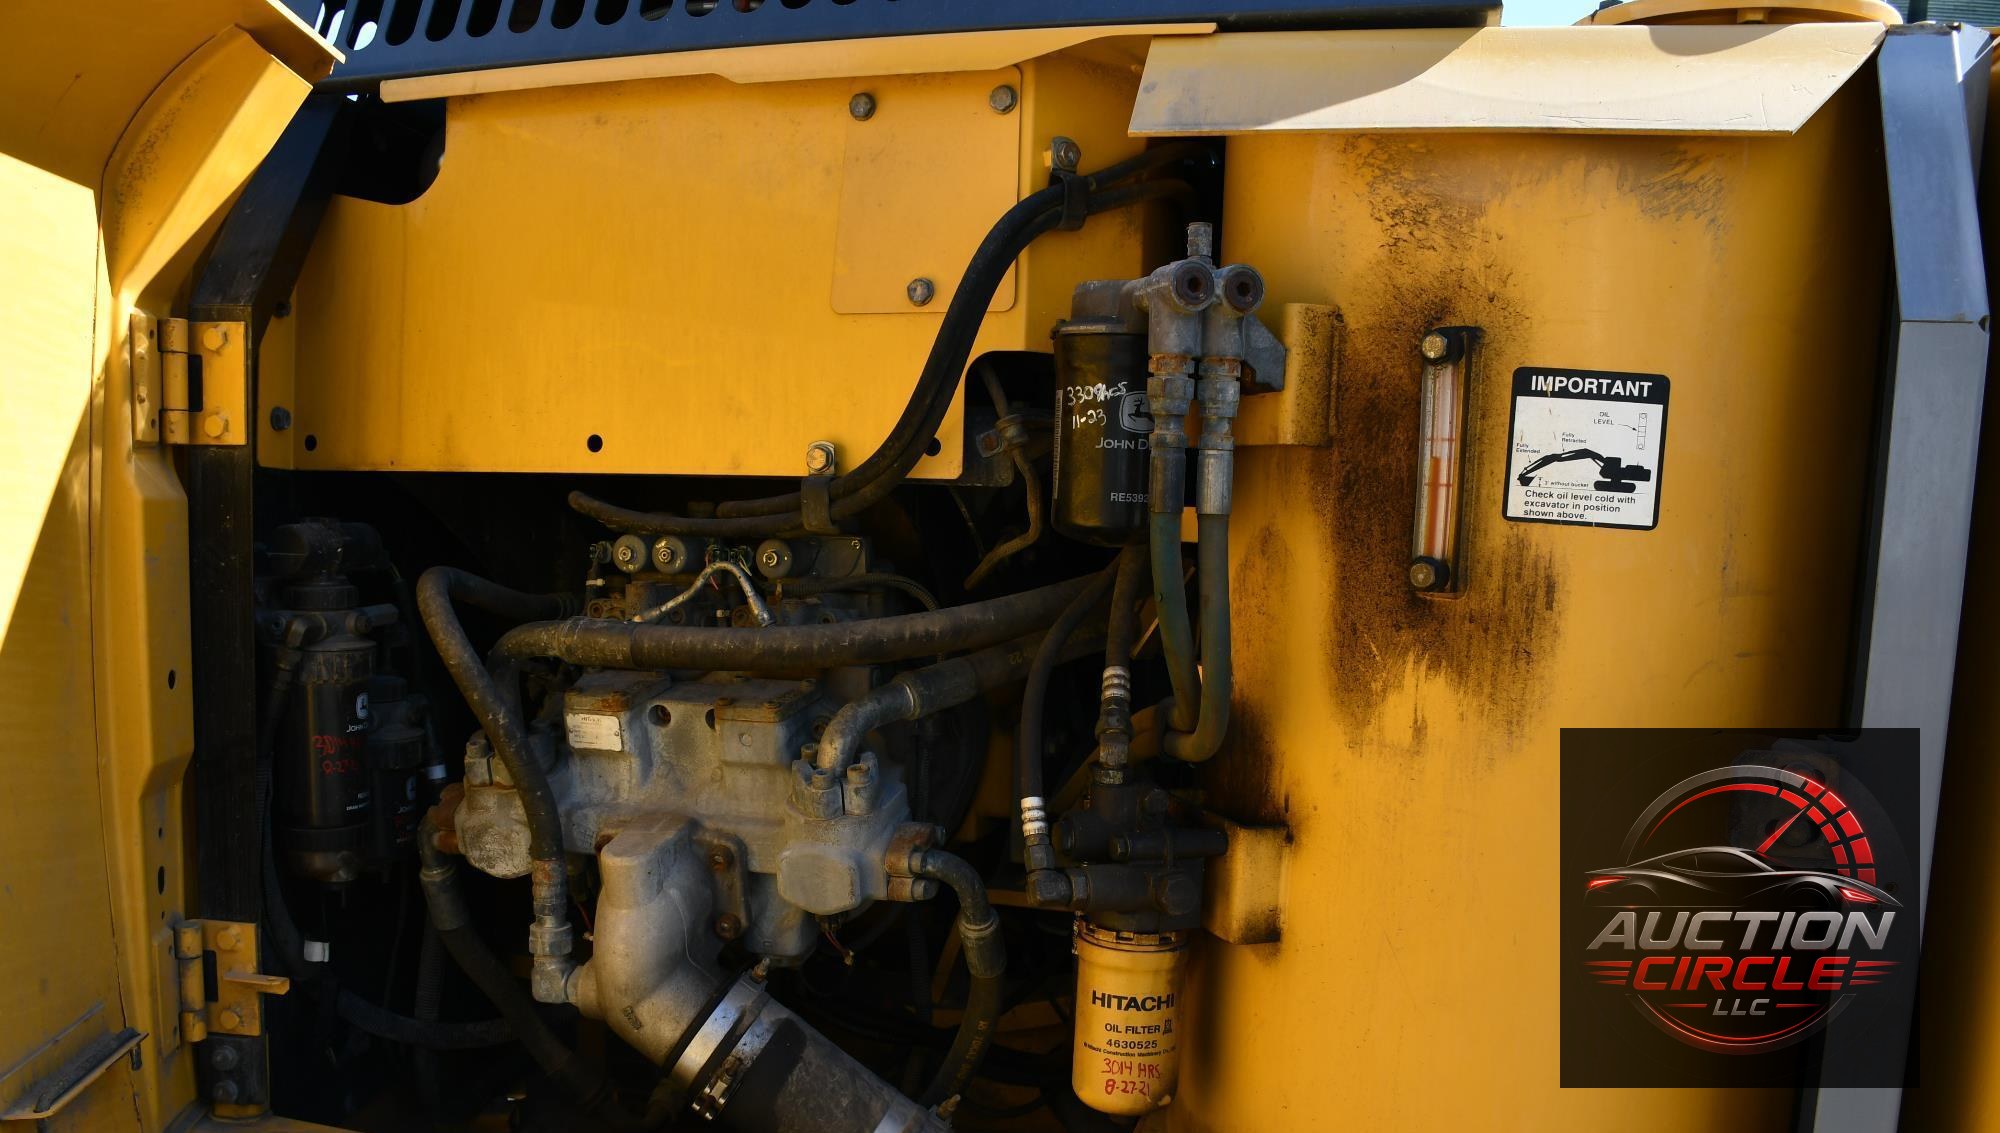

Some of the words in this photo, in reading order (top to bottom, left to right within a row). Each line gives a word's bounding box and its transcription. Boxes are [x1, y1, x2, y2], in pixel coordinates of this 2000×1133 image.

[1531, 375, 1653, 397] IMPORTANT
[1072, 408, 1107, 430] 11-23
[1593, 418, 1615, 426] LEVEL
[1095, 437, 1135, 449] JOHN
[1525, 489, 1554, 499] Check
[1556, 491, 1568, 500] oil
[1571, 492, 1592, 501] level
[1594, 495, 1615, 503] cold
[1617, 496, 1636, 504] with
[1524, 500, 1569, 509] excavator
[1572, 501, 1581, 510] in
[1583, 504, 1621, 513] position
[1523, 508, 1554, 517] shown
[1556, 510, 1587, 520] above.
[1092, 990, 1175, 1011] HITACHI
[1105, 1023, 1122, 1033] OIL
[1125, 1024, 1161, 1034] FILTER
[1106, 1038, 1158, 1049] 4630525
[1103, 1048, 1136, 1057] Construction
[1101, 1057, 1133, 1076] 3014
[1137, 1062, 1161, 1079] HRS
[1104, 1078, 1150, 1097] 8-27-21
